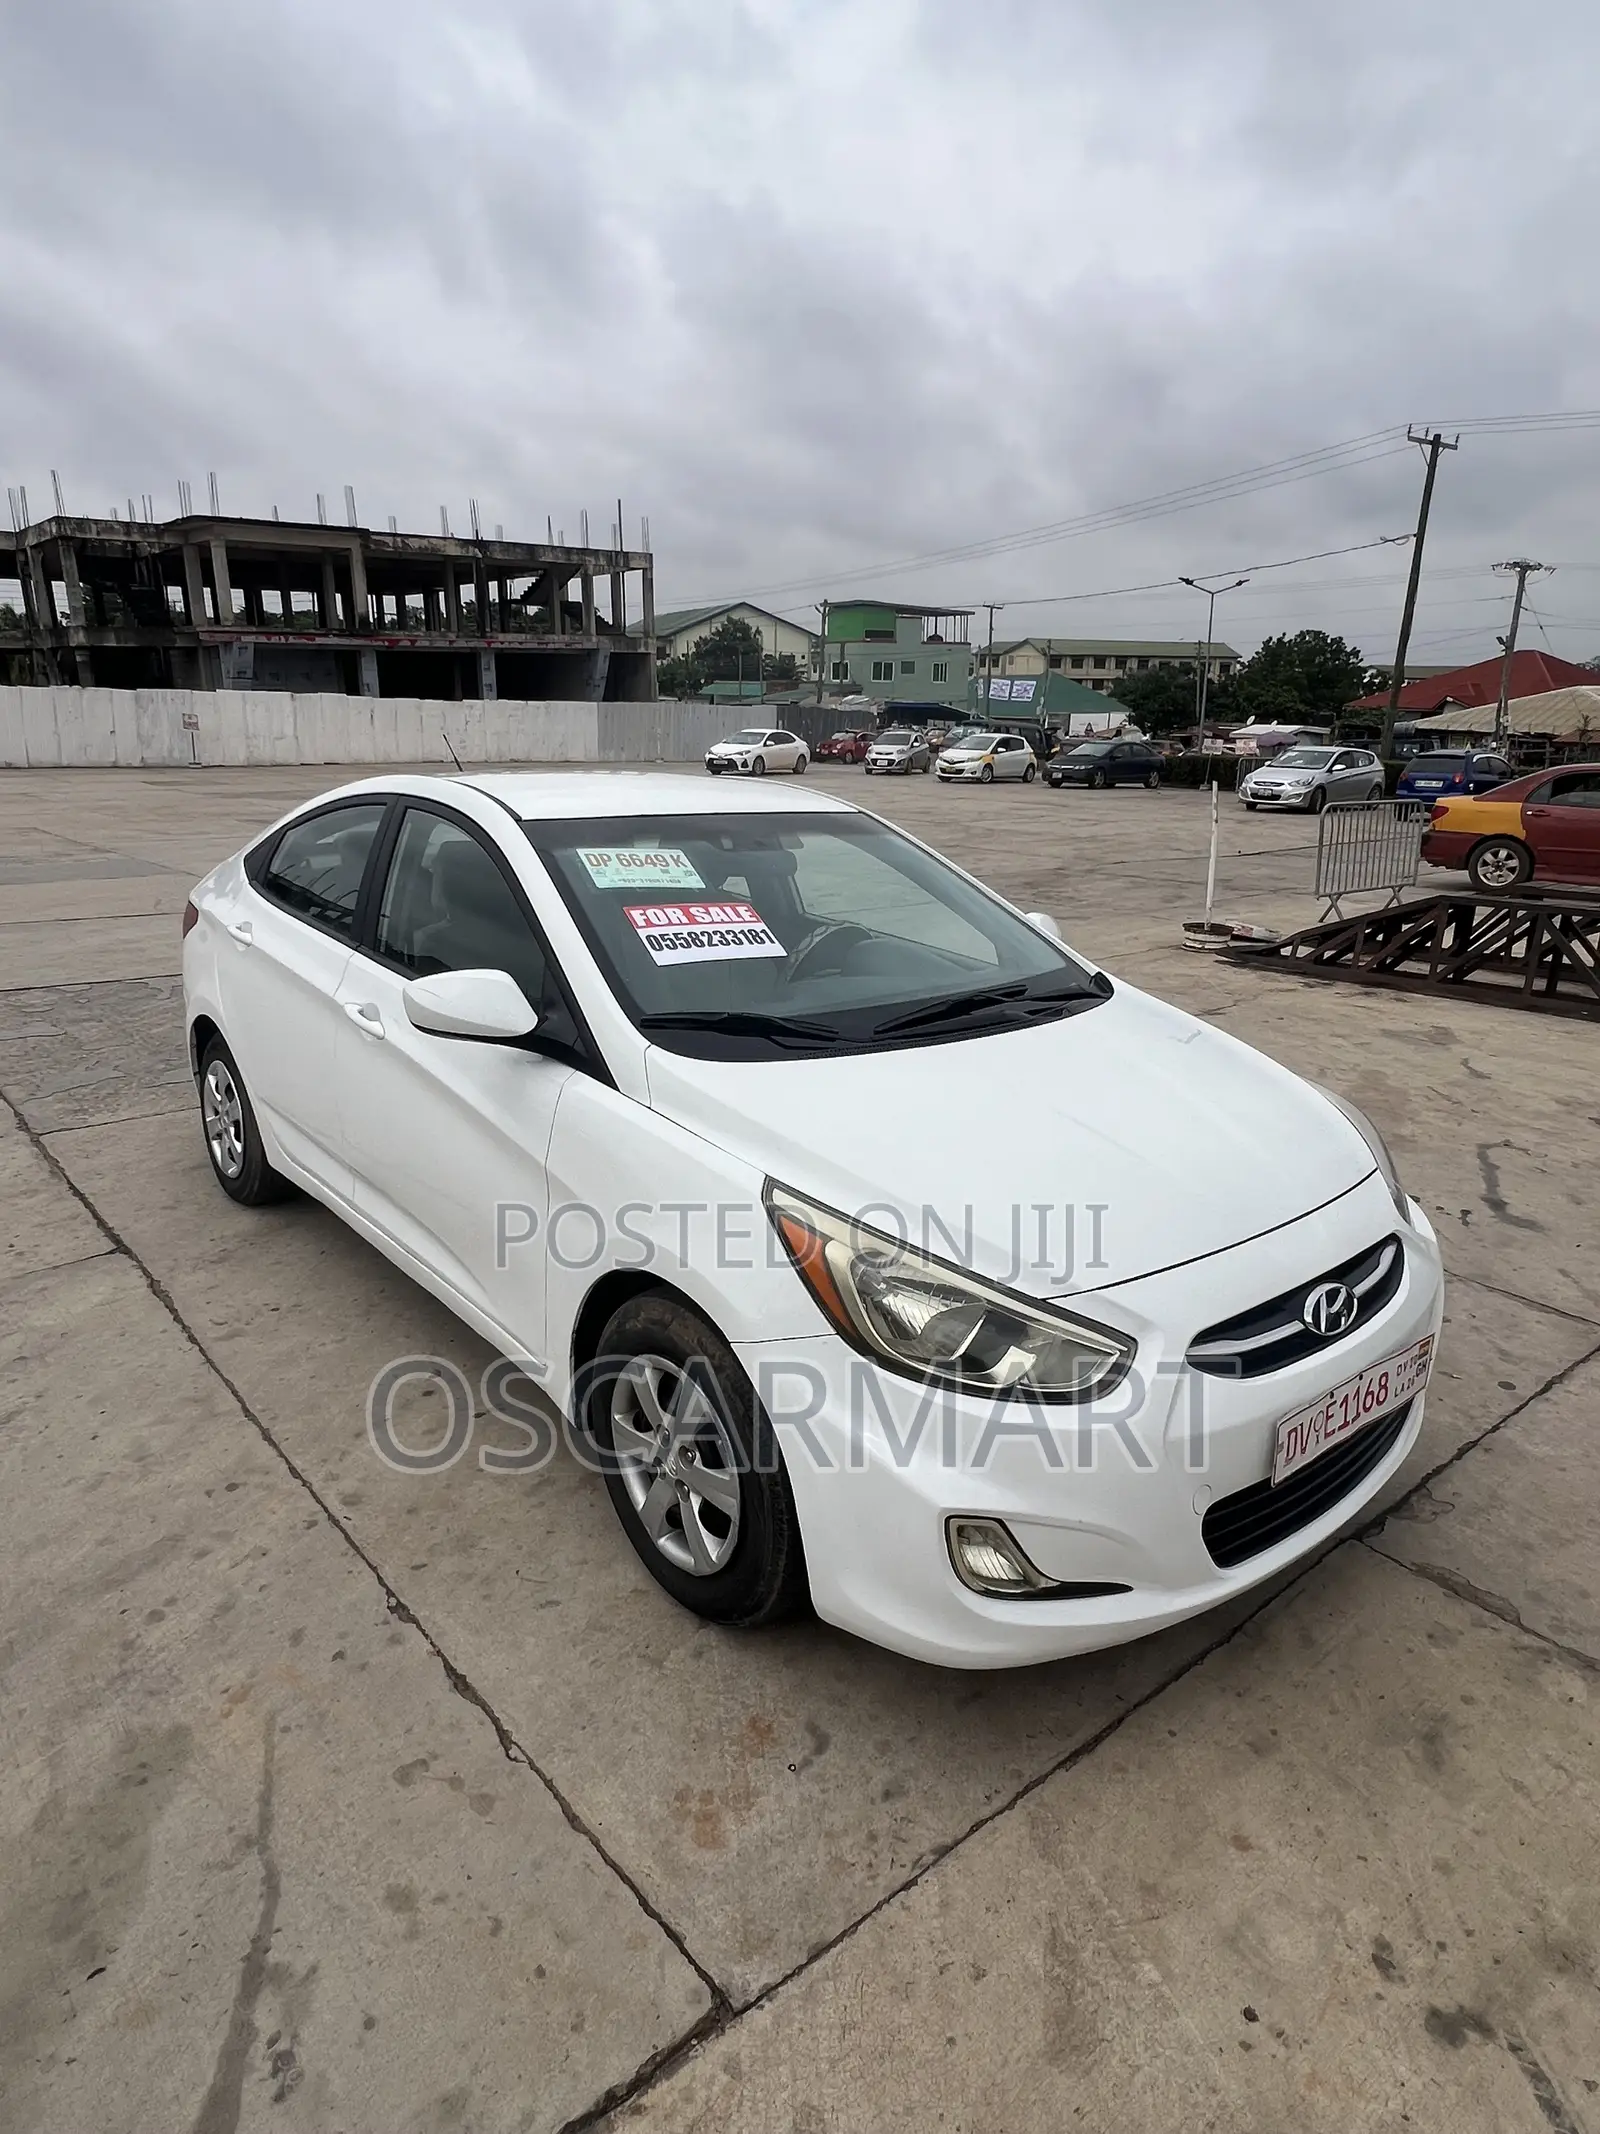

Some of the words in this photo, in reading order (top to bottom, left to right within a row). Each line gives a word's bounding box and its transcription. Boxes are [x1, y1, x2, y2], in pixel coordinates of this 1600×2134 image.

[584, 853, 612, 867] DP
[616, 854, 670, 868] 6649
[670, 854, 687, 868] K
[630, 908, 689, 927] FOR
[691, 905, 757, 924] SALE
[645, 928, 775, 953] 0558233181
[1286, 1416, 1314, 1460] DV
[1323, 1371, 1389, 1440] E1168
